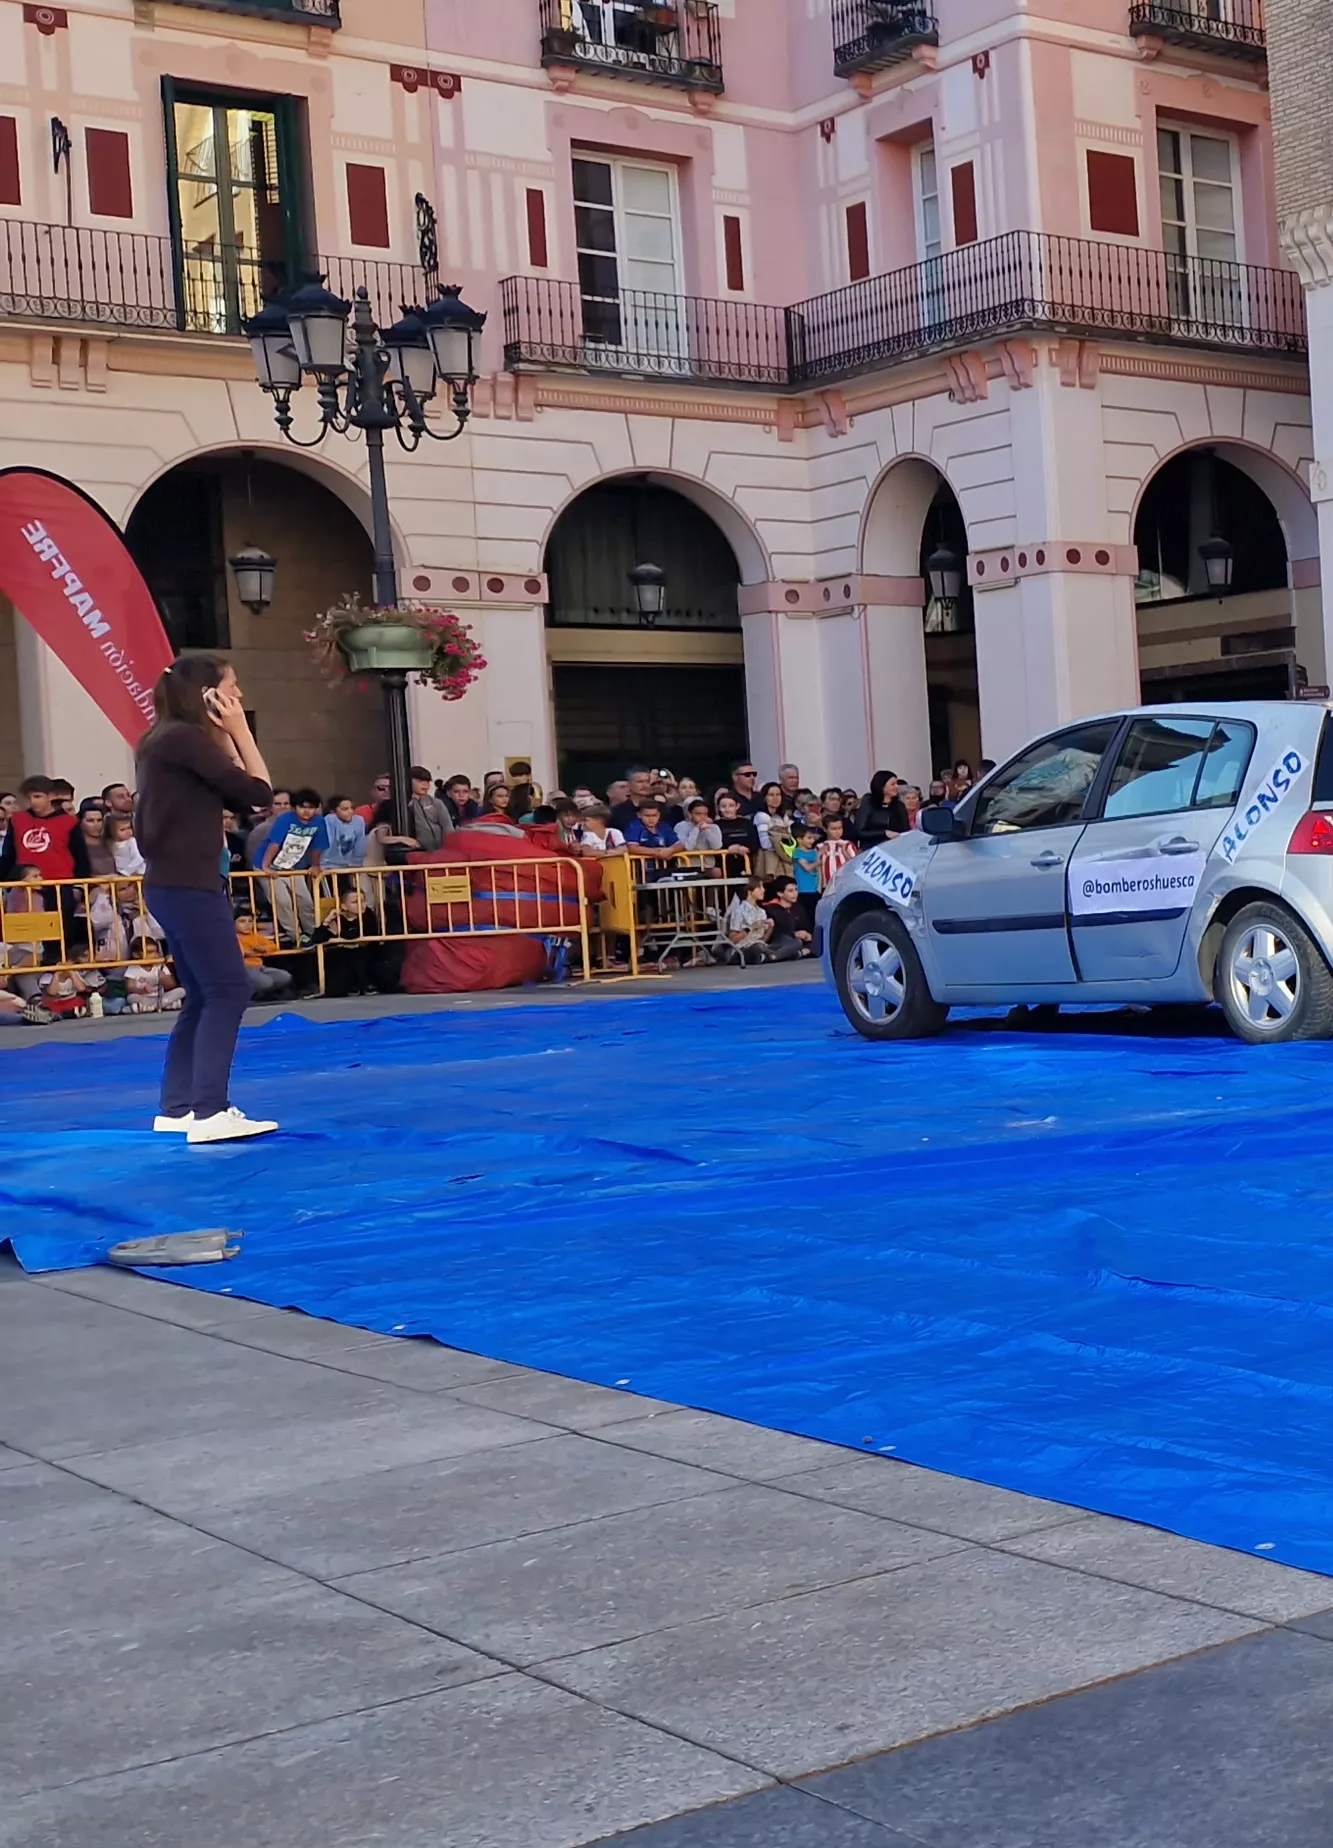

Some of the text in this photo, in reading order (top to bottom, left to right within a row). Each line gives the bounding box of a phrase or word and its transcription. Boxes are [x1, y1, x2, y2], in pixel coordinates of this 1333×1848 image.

[1222, 751, 1302, 862] ALONSO
[862, 852, 914, 899] ALONSO
[1082, 874, 1195, 898] @bomberoshuesca
